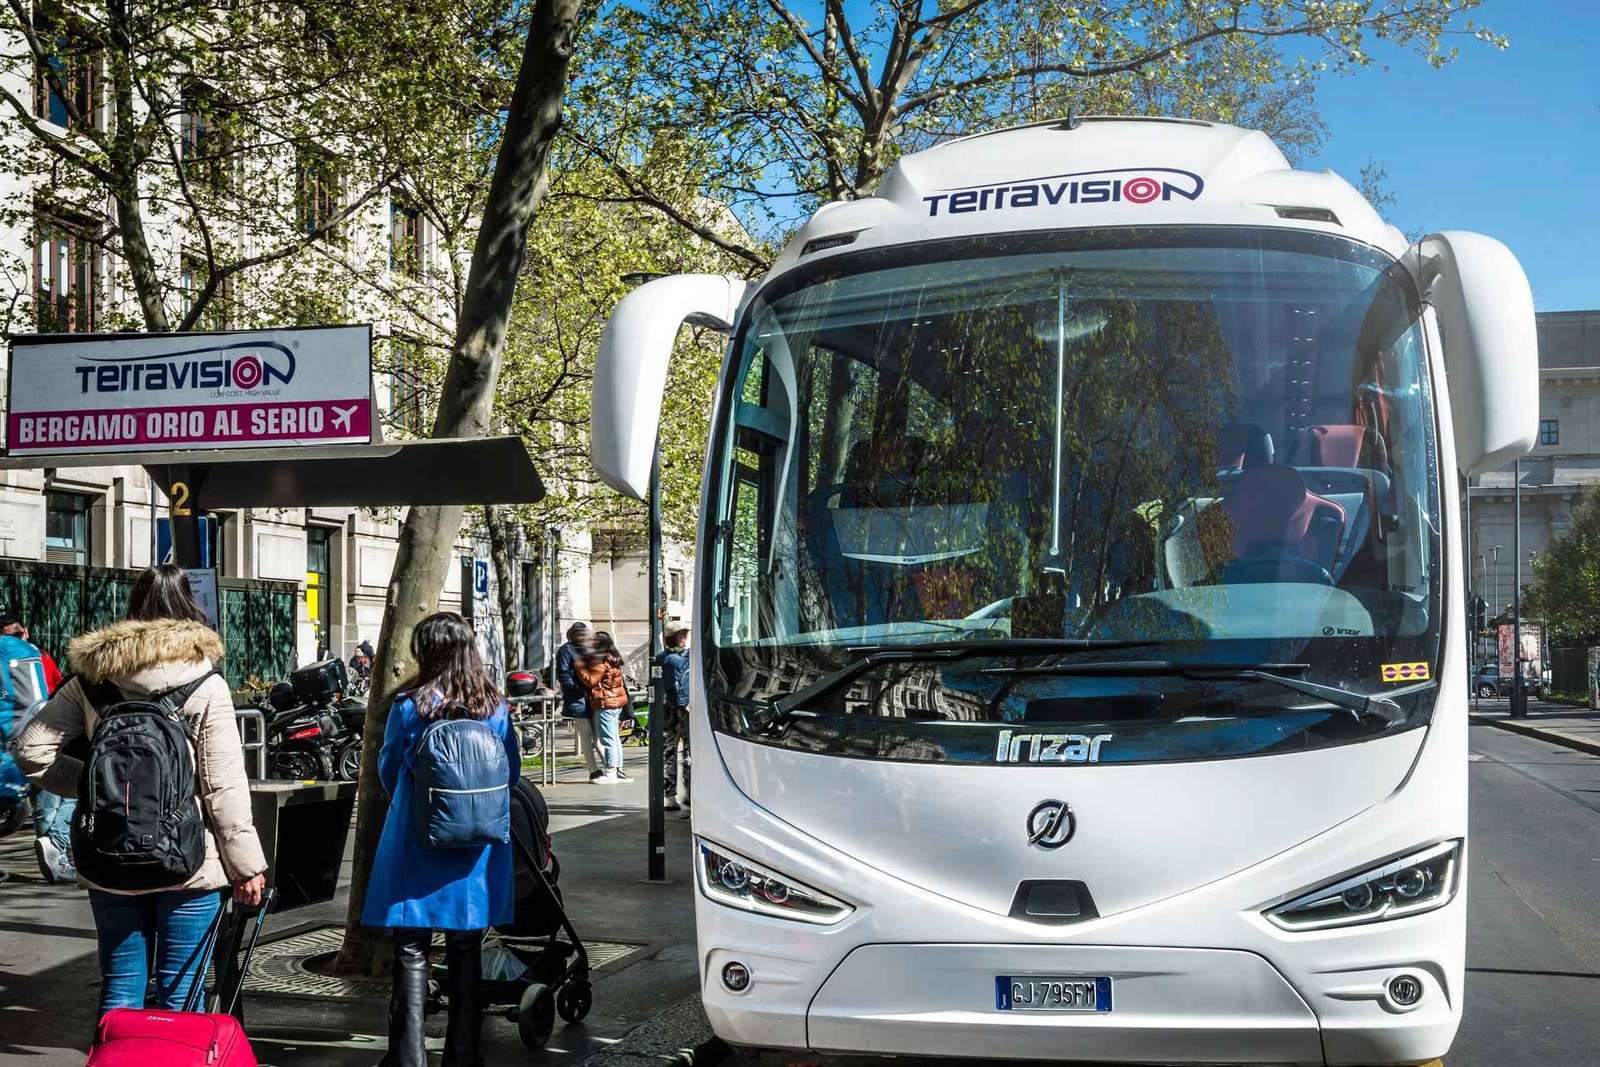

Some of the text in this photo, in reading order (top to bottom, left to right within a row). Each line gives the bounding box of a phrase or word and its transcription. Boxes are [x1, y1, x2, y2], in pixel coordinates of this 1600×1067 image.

[19, 406, 324, 444] BERGAMO ORIO AL SERIO
[170, 481, 192, 516] 2
[477, 565, 486, 588] P
